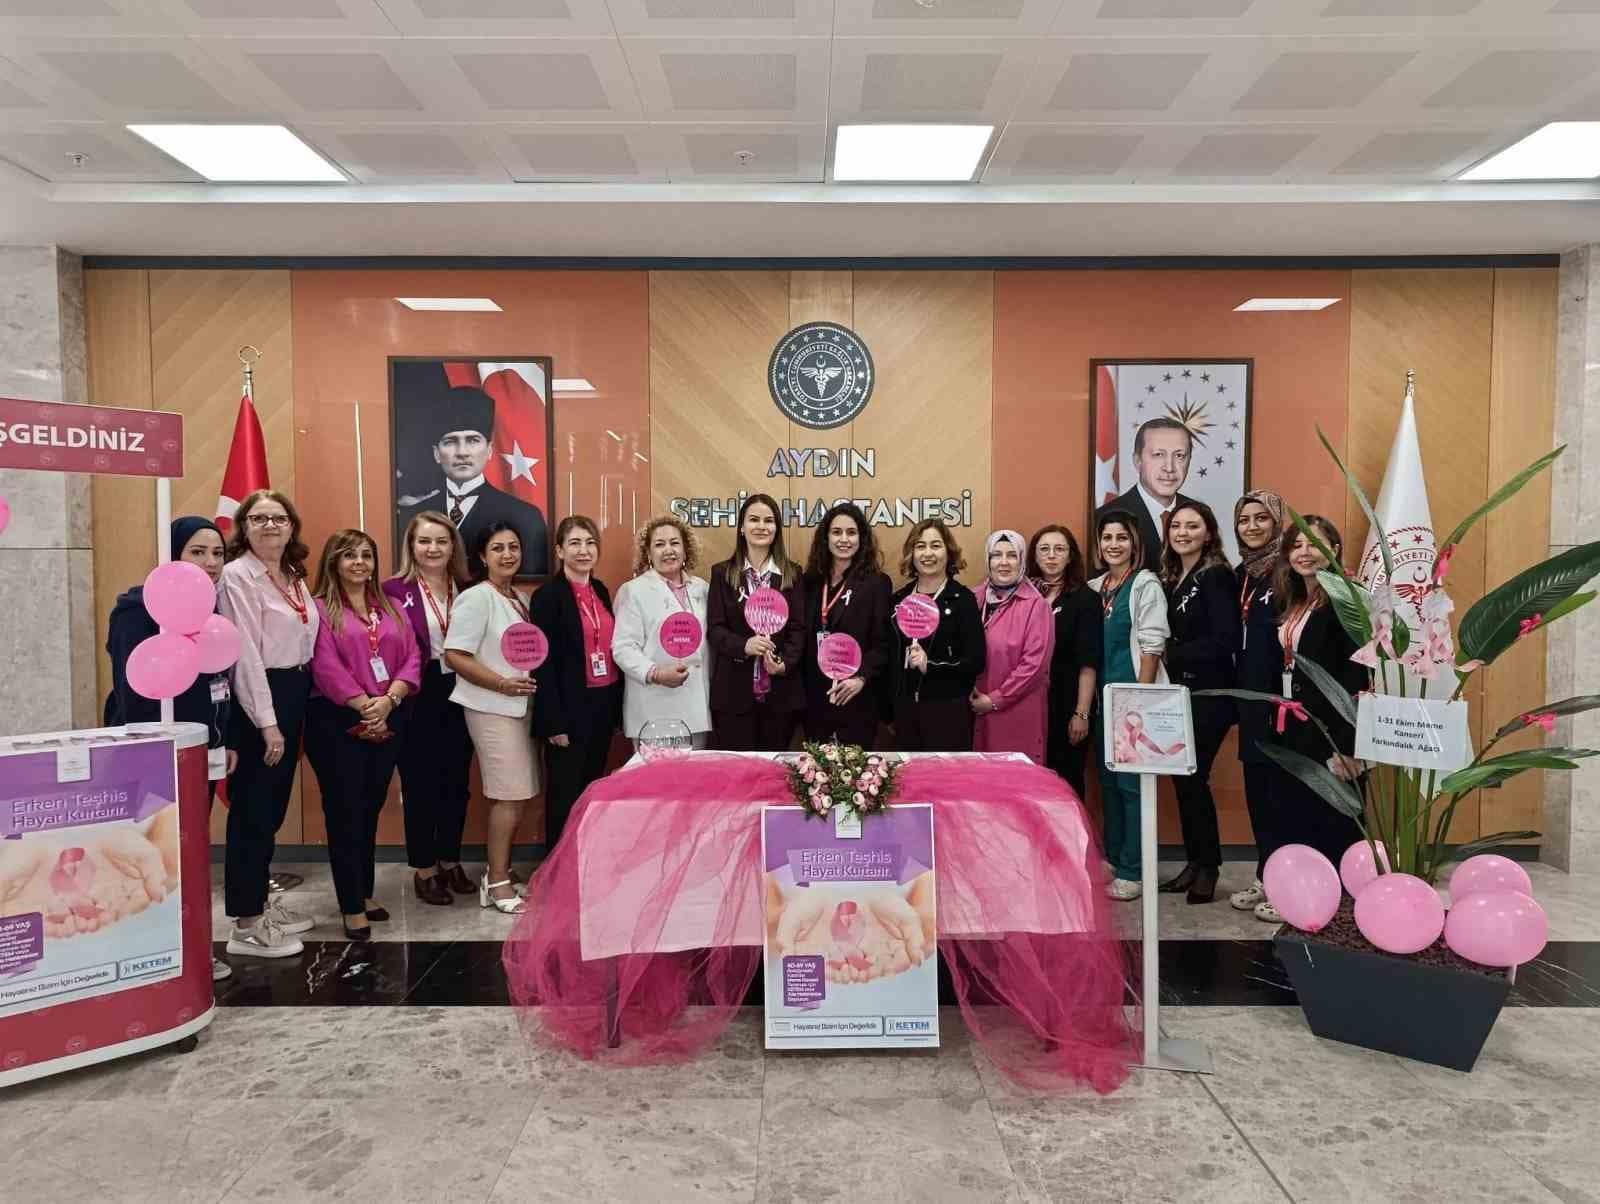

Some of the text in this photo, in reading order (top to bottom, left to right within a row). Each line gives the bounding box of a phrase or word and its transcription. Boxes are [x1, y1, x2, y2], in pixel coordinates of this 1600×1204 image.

[767, 448, 875, 477] AYDIN
[783, 489, 973, 527] HATANESİ
[1396, 719, 1415, 728] Ekim
[1394, 729, 1424, 739] Kanseri
[13, 799, 67, 815] Erken
[13, 813, 62, 830] Hayat
[802, 850, 892, 866] Erken Teşhis
[802, 865, 839, 879] Hayat
[132, 956, 172, 972] KETEM
[895, 1021, 930, 1030] KETEM
